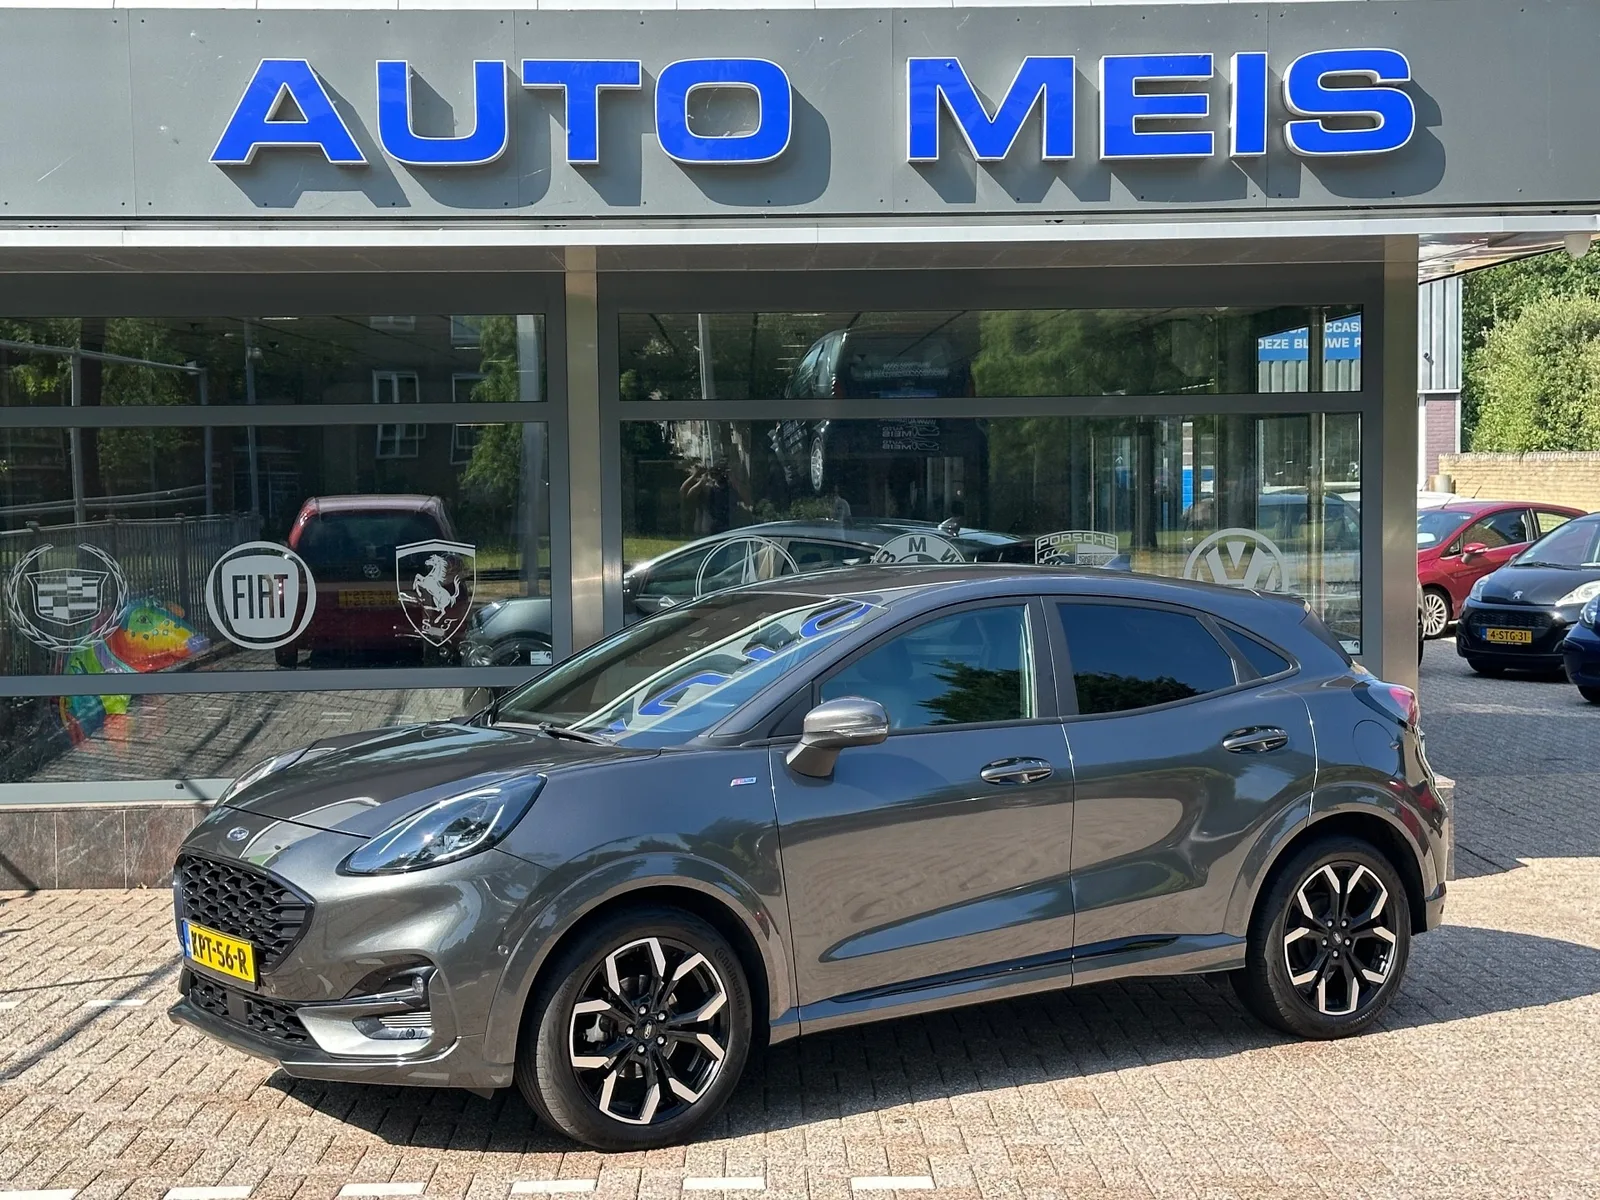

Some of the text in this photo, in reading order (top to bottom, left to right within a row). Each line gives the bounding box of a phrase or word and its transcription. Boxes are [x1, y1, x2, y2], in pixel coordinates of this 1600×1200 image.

[208, 47, 1416, 168] AUTO MEIS
[1038, 533, 1116, 551] PORSCHE
[232, 573, 289, 620] FIAT
[1490, 630, 1527, 641] 4-STG-31
[190, 930, 249, 977] KPT-56-R
